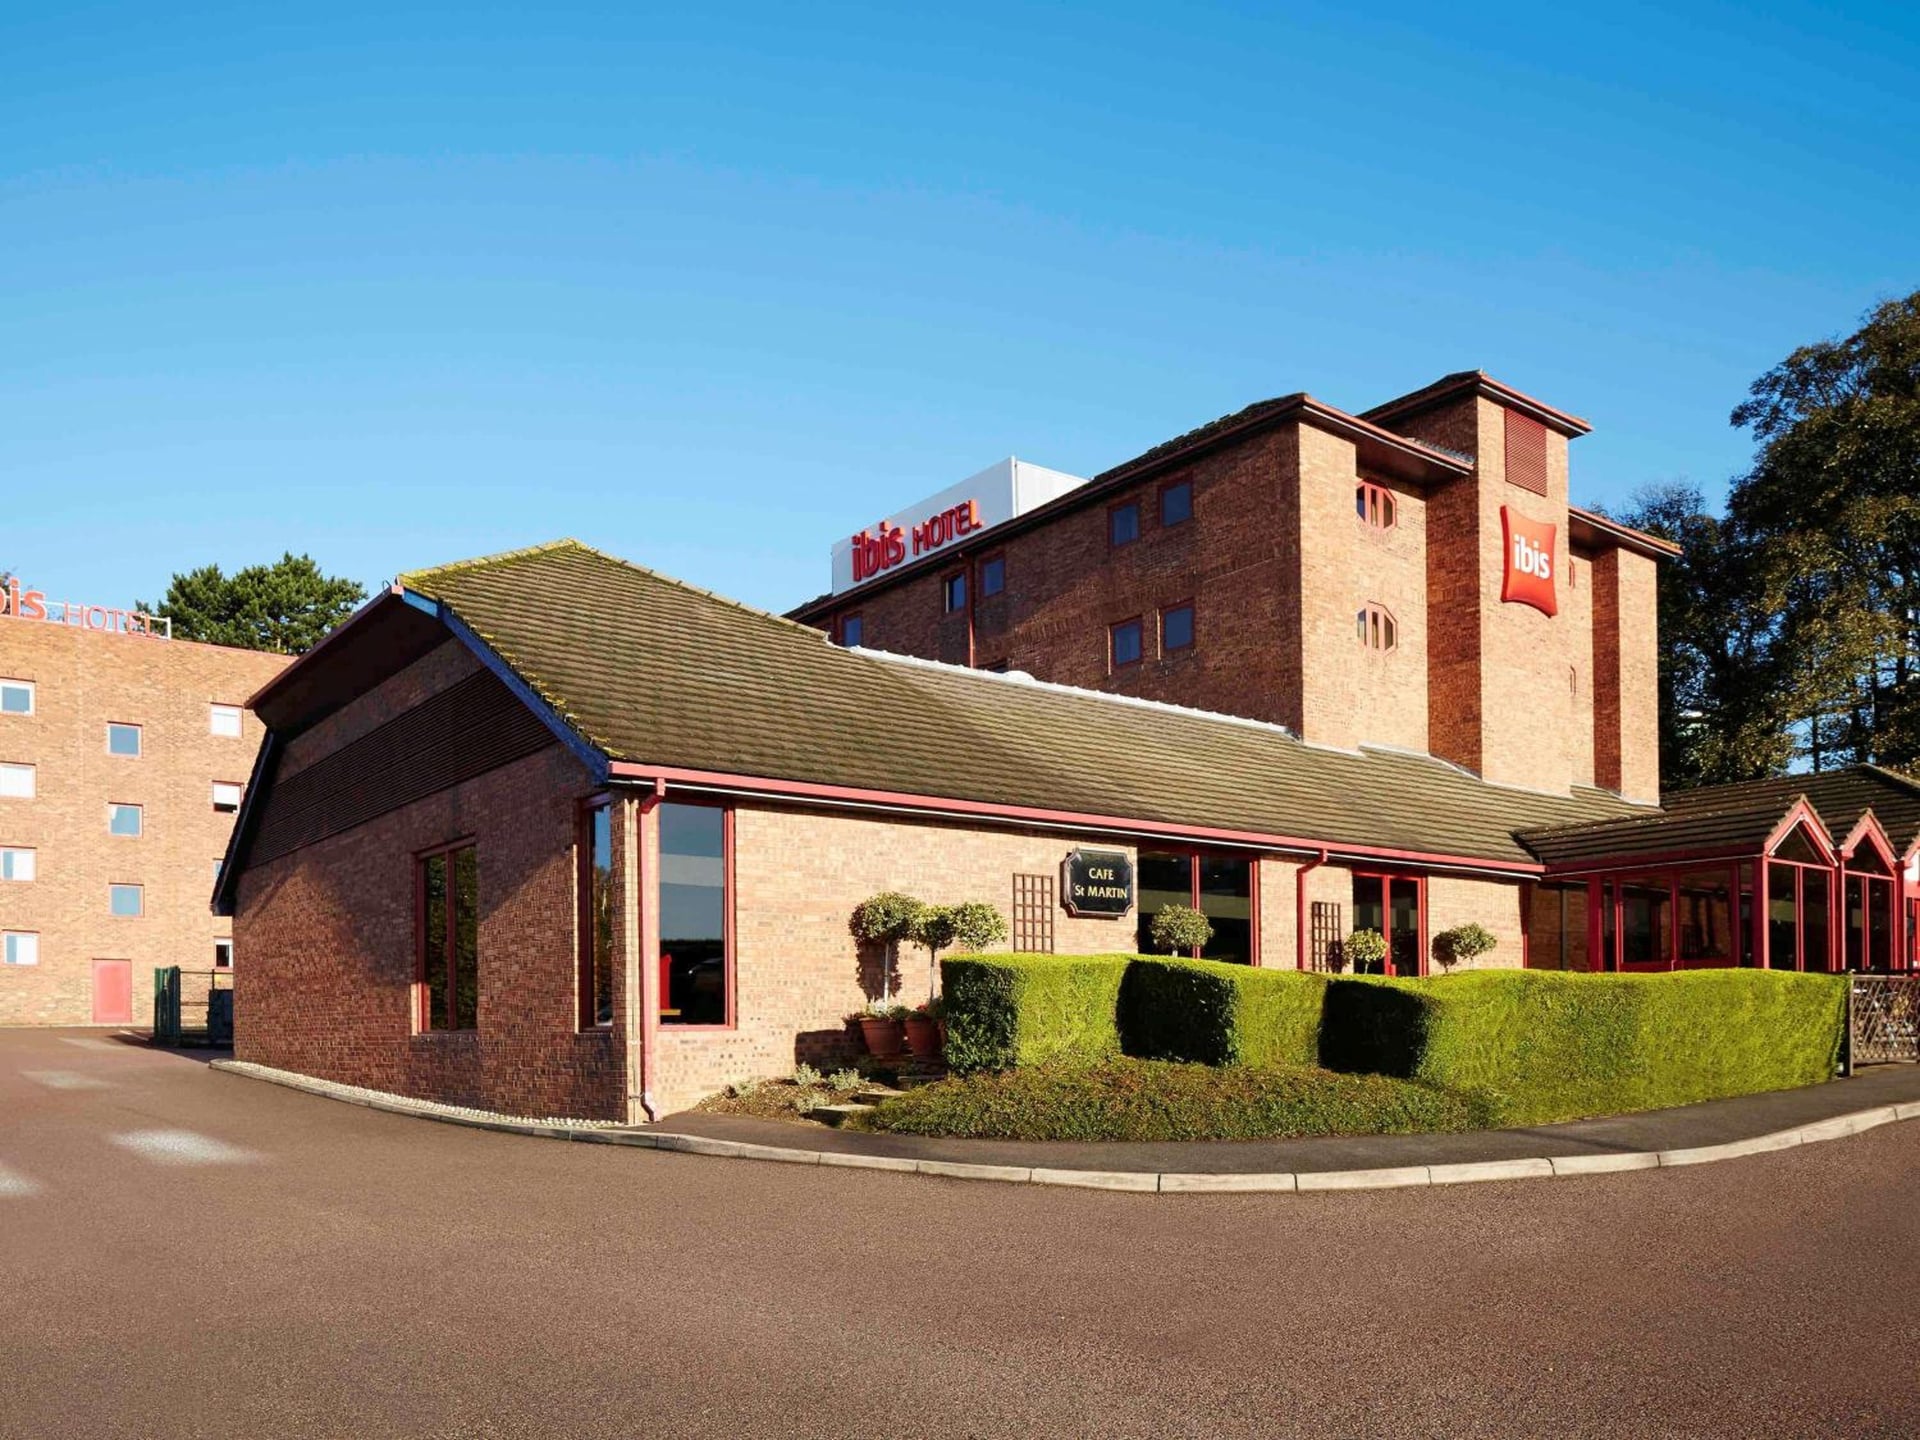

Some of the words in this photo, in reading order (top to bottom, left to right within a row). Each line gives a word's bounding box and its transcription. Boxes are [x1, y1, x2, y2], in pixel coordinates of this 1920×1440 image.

[852, 520, 906, 582] ibis
[912, 499, 983, 556] HOTEL
[1514, 533, 1551, 579] ibis
[64, 602, 160, 639] HOTEL
[1074, 884, 1085, 897] St
[1087, 885, 1128, 899] MARTIN
[1088, 867, 1115, 881] CAFE
